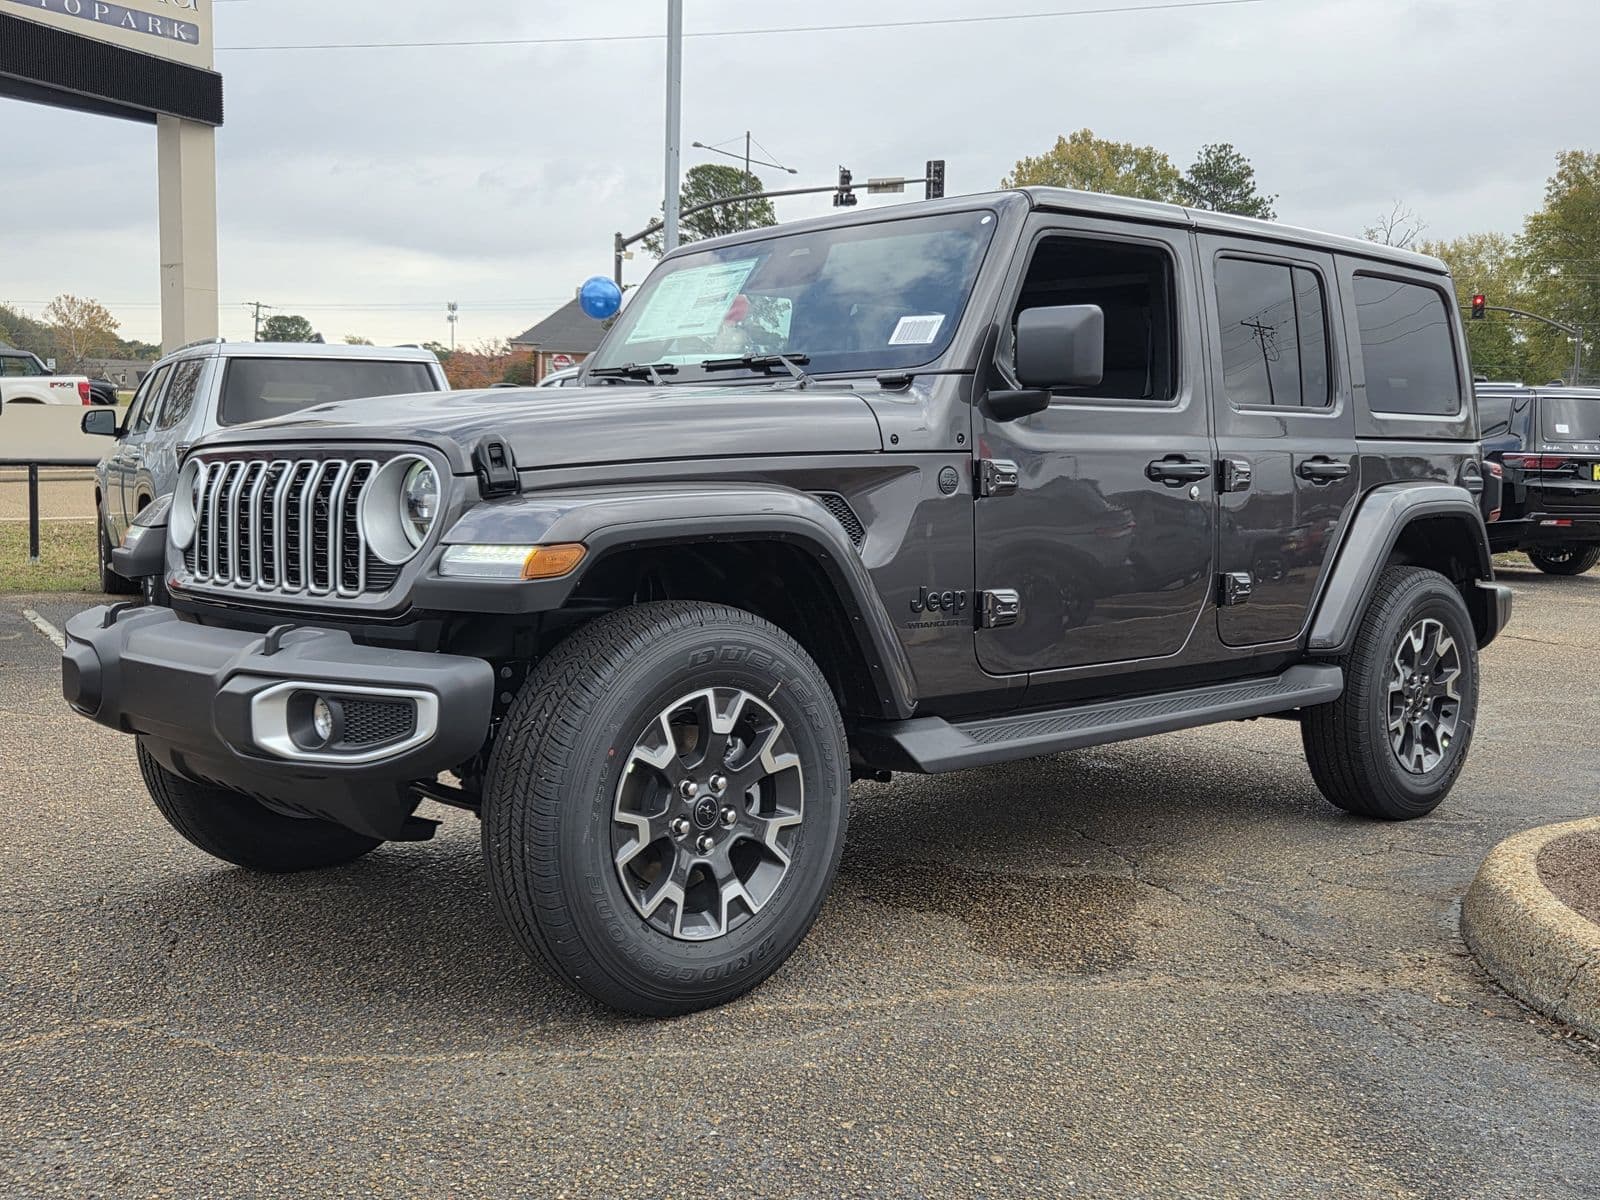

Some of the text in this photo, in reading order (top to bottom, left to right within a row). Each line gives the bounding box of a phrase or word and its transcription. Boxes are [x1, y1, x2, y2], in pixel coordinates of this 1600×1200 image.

[906, 620, 960, 630] WRANGLER
[910, 586, 966, 616] Jeep
[688, 645, 830, 731] DUELER
[584, 872, 777, 983] BRIDGESTONE
